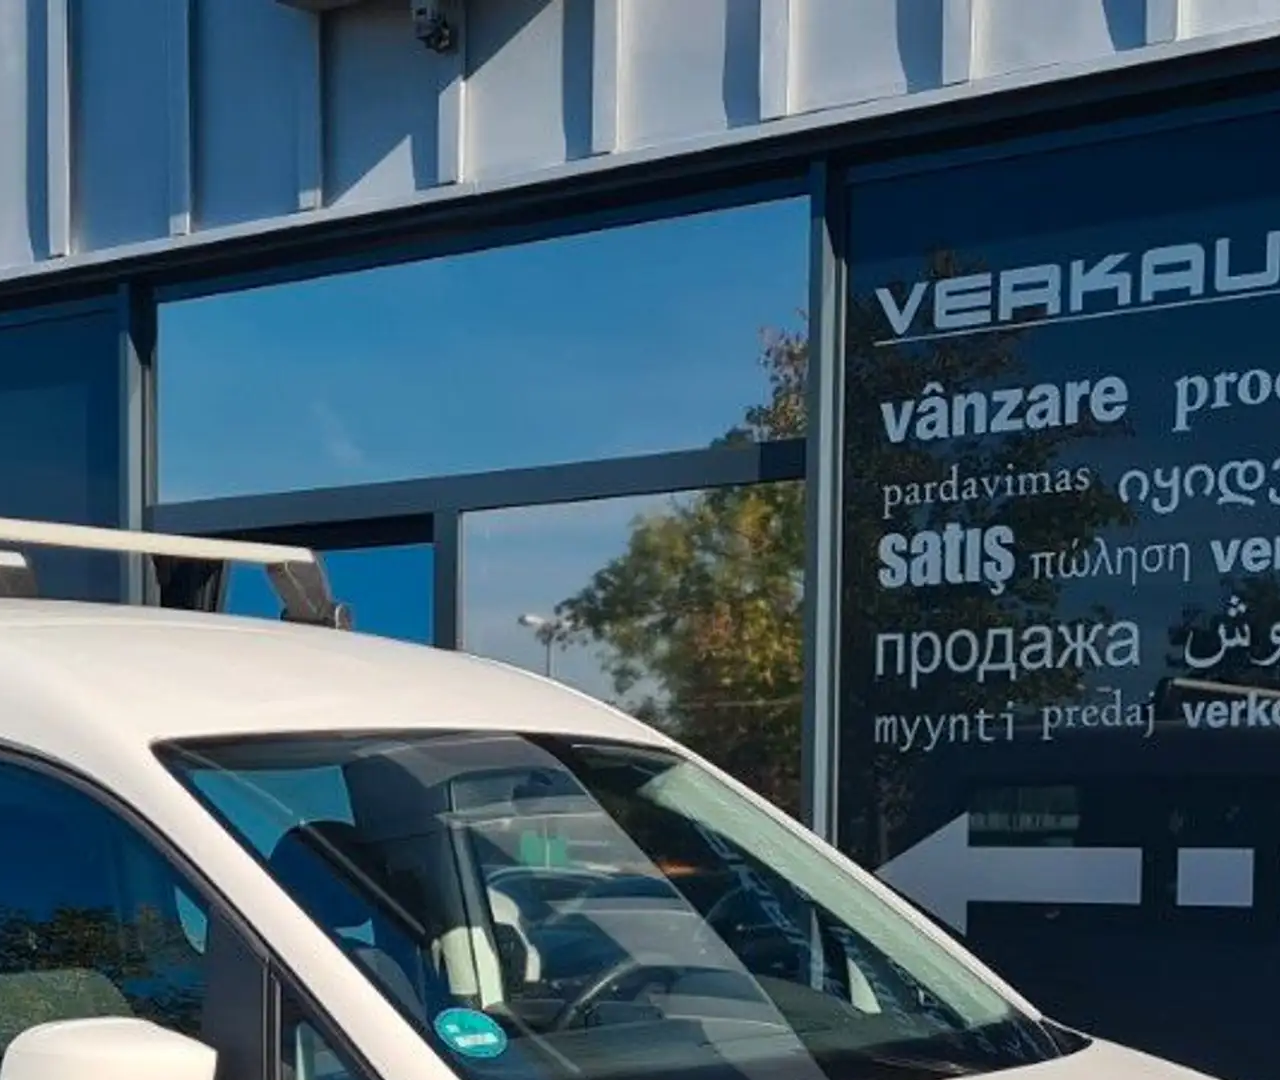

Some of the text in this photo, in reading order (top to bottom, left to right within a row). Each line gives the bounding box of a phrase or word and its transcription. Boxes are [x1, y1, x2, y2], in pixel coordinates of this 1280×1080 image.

[881, 375, 1129, 443] vânzare
[882, 462, 1091, 519] pardavimas
[878, 522, 1015, 595] satış
[1030, 537, 1192, 584] πώληση
[874, 619, 1141, 687] продажа
[875, 701, 1015, 752] myynti
[1041, 690, 1156, 741] predaj
